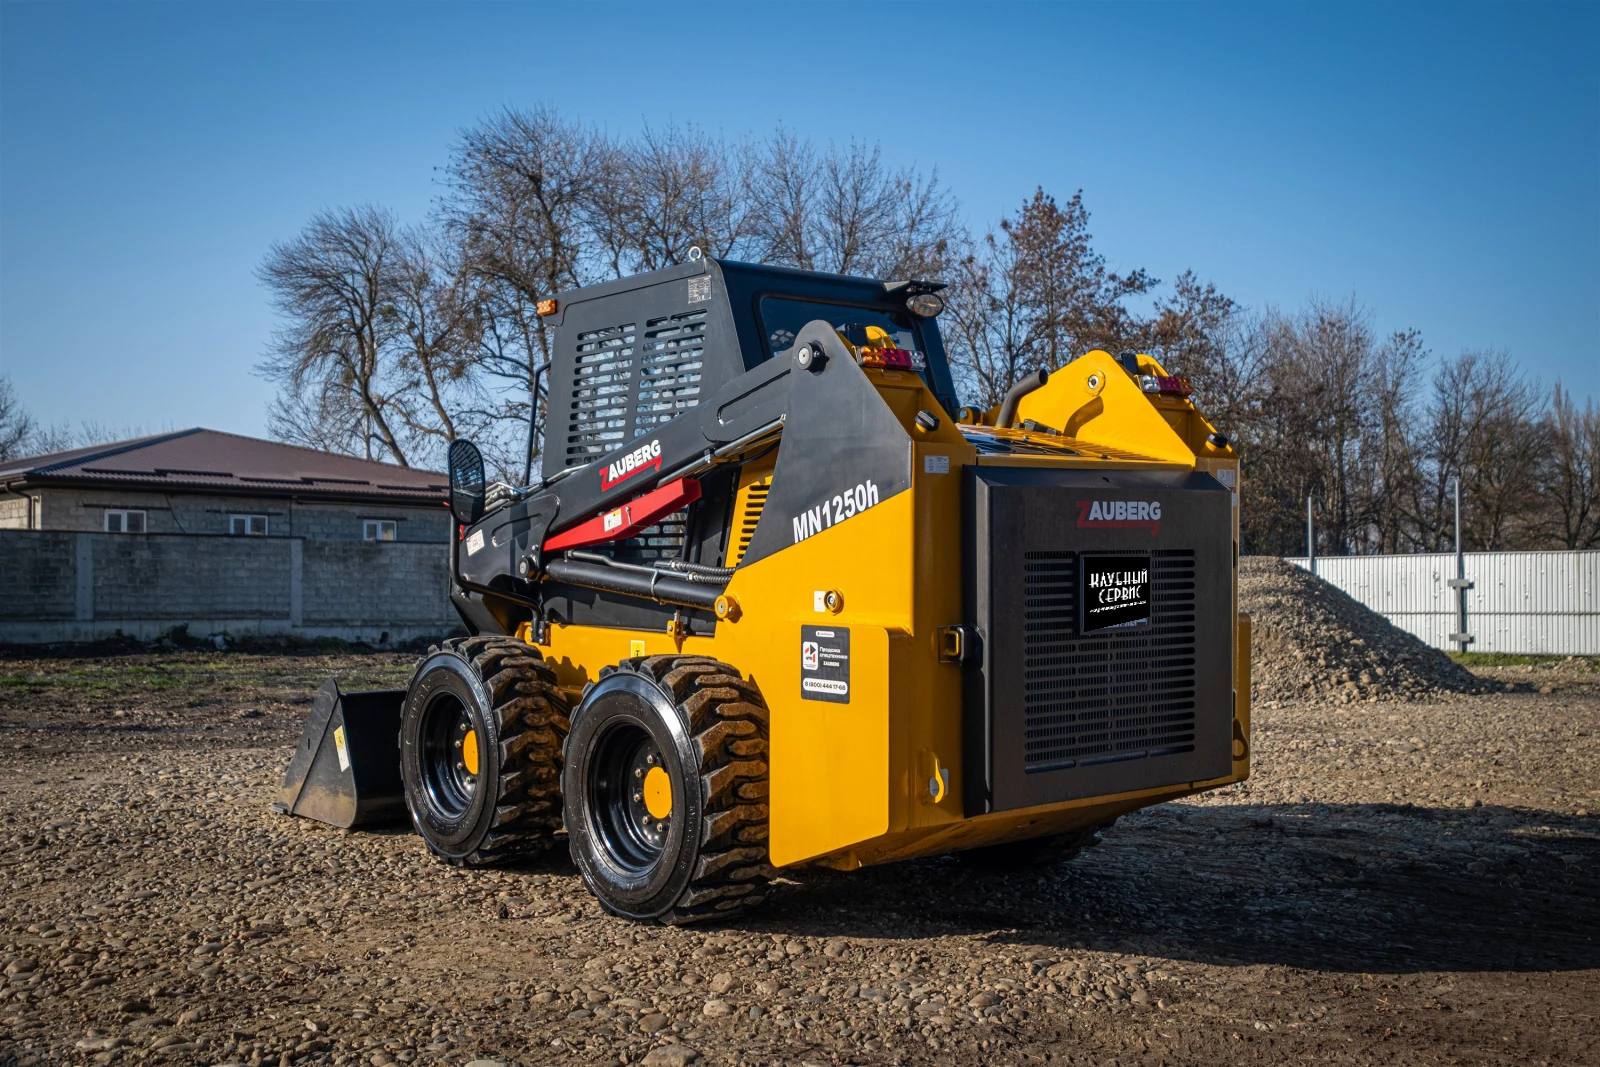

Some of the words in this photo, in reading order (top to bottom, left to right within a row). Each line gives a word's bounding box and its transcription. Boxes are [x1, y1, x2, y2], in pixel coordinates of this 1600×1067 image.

[599, 439, 662, 492] ZAUBERG
[793, 479, 879, 544] MN1250h
[1077, 500, 1161, 530] ZAUBERG
